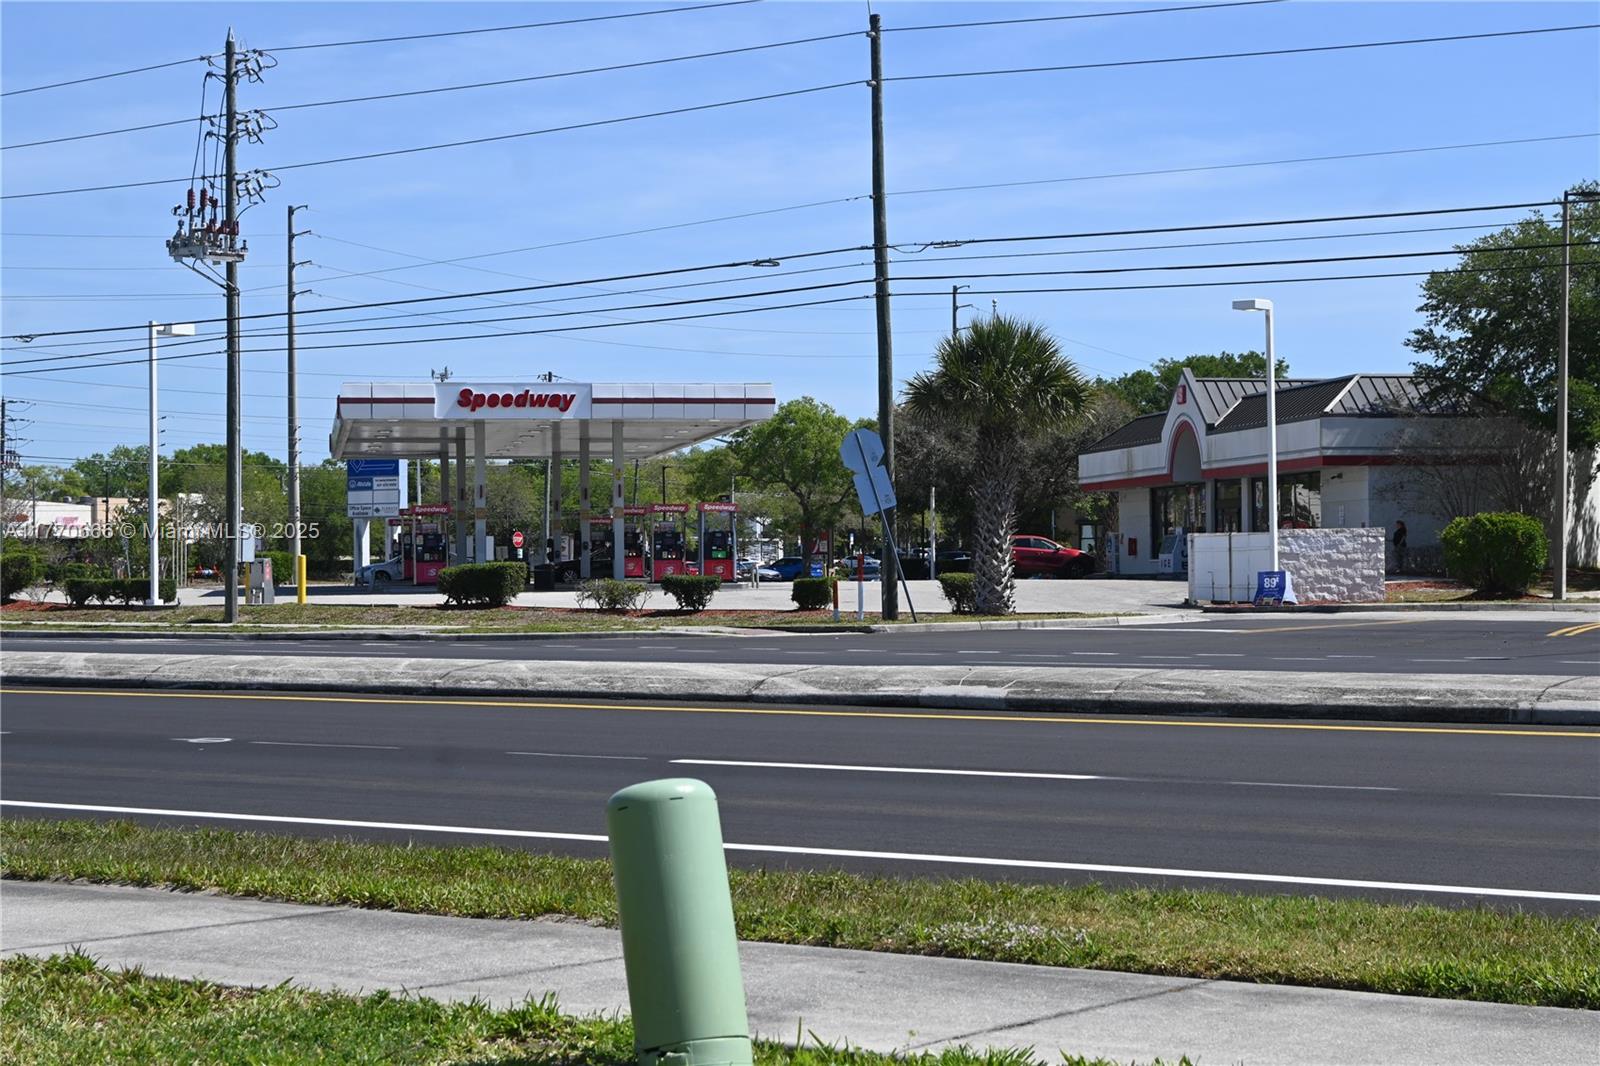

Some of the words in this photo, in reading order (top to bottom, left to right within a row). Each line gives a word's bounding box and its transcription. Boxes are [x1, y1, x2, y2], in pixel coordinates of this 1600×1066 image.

[457, 388, 576, 412] Speedway
[654, 504, 686, 512] Speedway
[703, 503, 736, 511] Speedway
